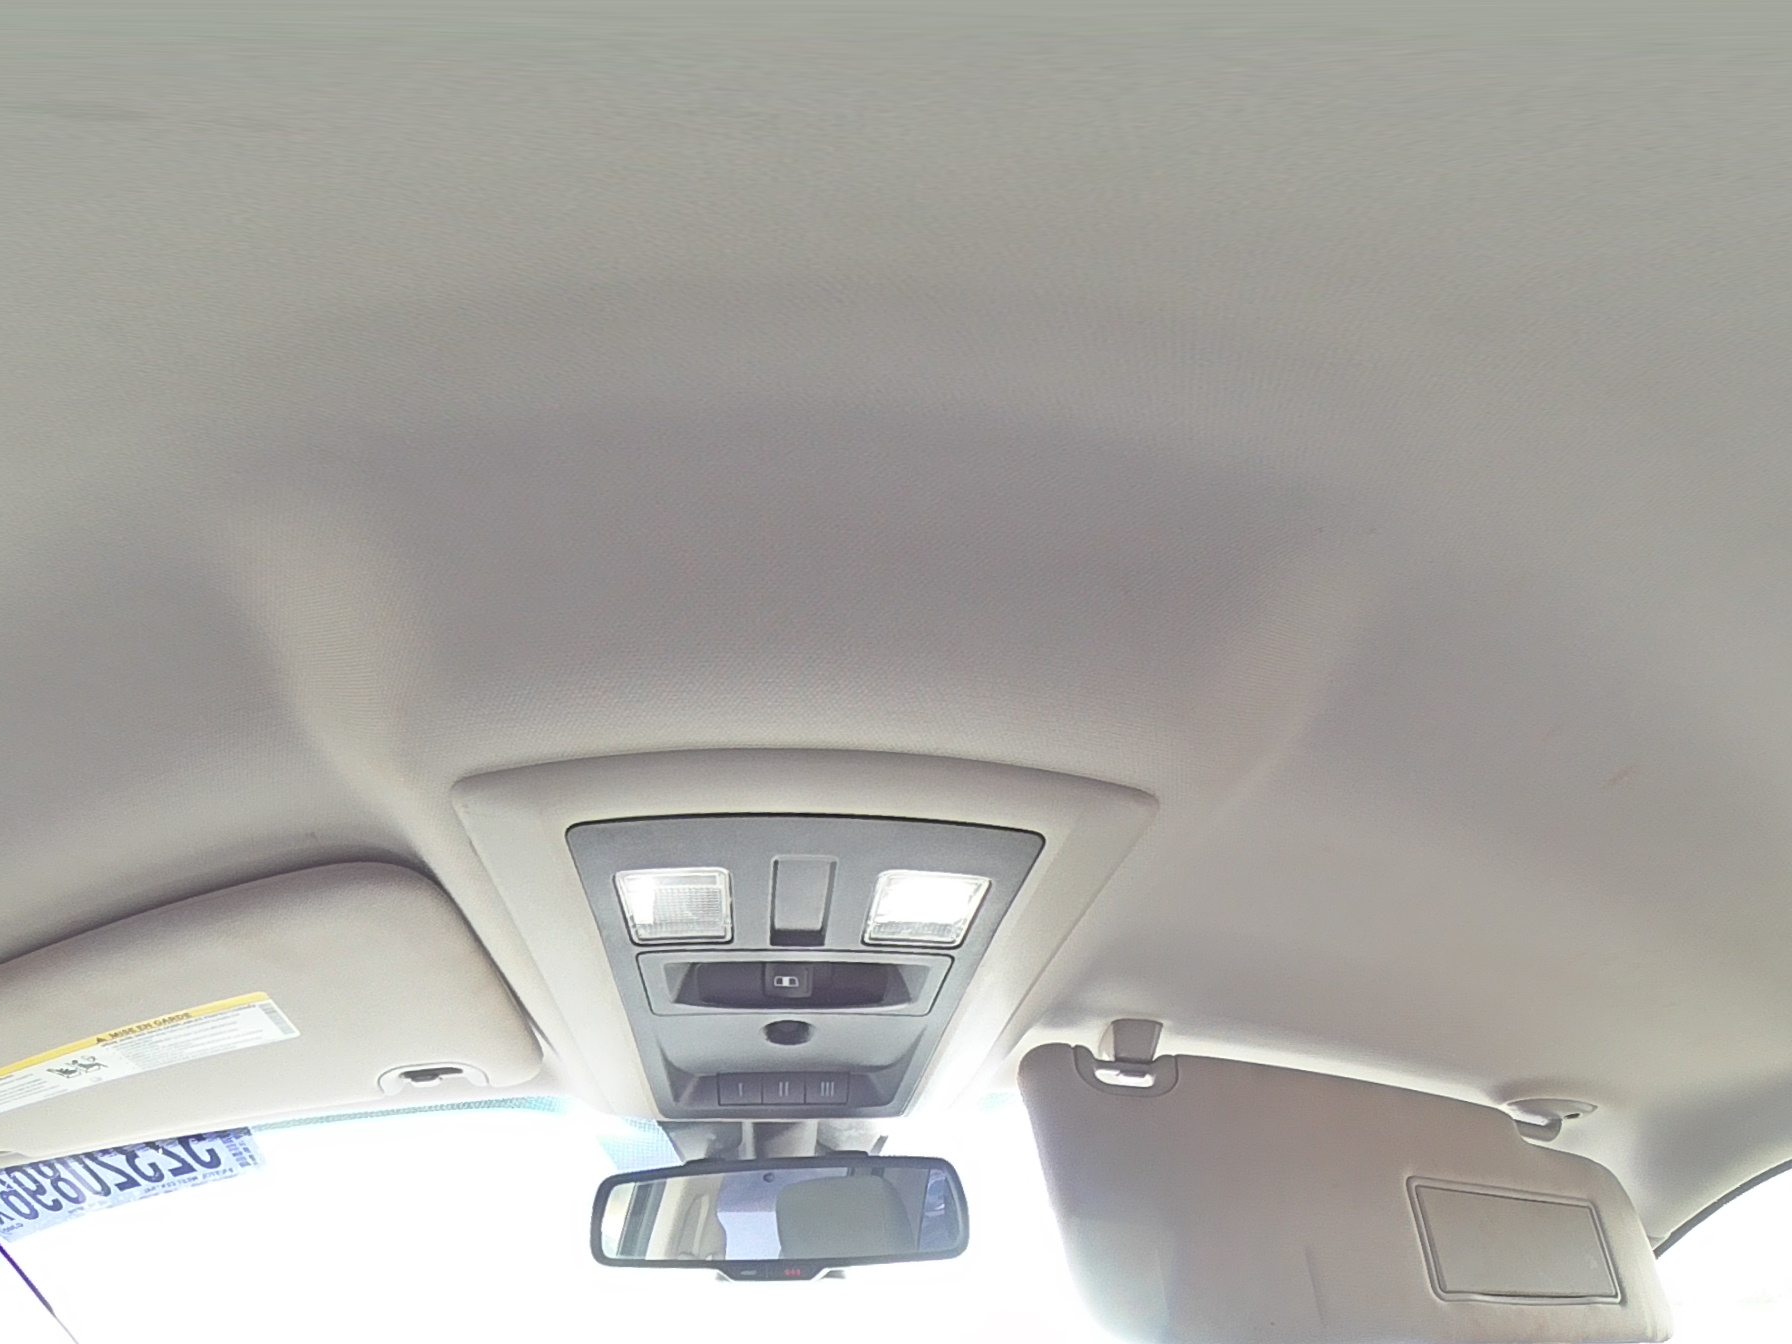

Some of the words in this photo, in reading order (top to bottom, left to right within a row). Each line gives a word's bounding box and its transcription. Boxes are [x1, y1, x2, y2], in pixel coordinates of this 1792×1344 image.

[109, 1025, 134, 1039] MISE
[136, 1021, 153, 1033] EN
[153, 1012, 192, 1028] GARDE
